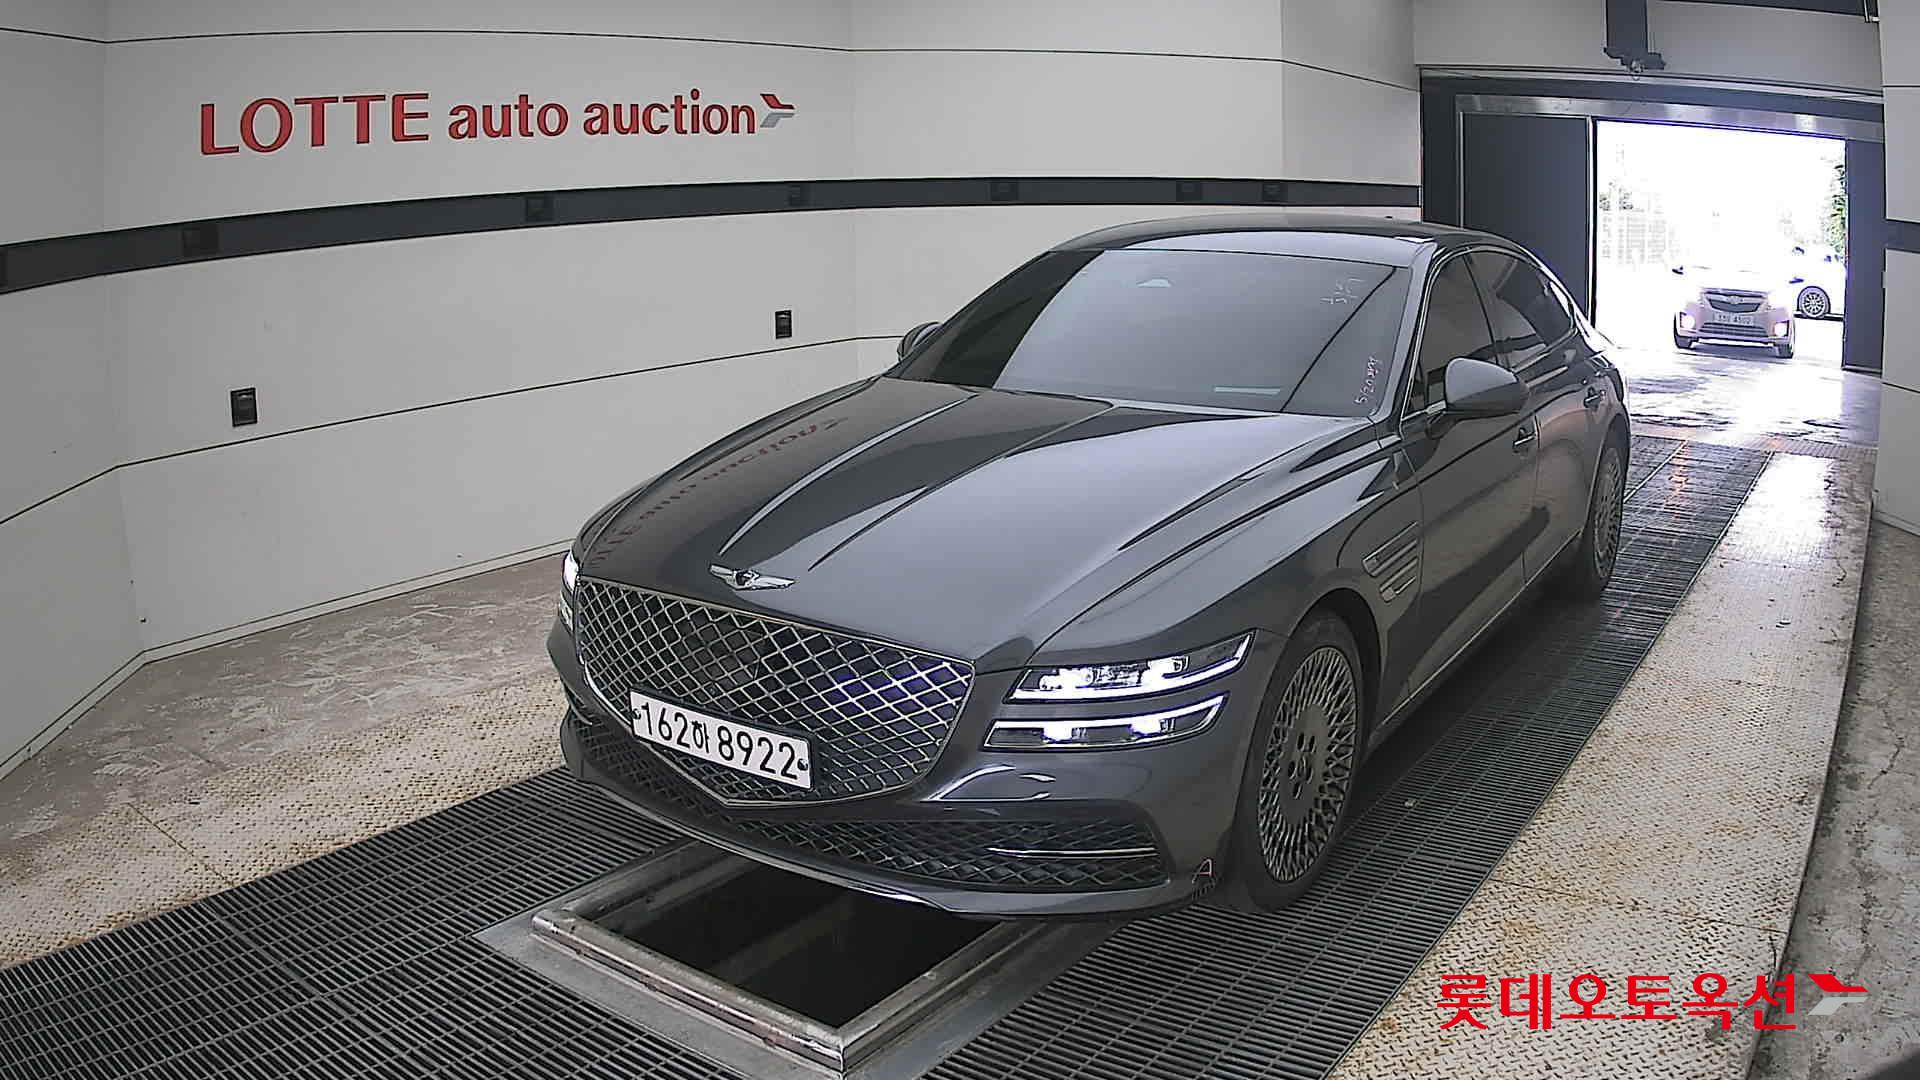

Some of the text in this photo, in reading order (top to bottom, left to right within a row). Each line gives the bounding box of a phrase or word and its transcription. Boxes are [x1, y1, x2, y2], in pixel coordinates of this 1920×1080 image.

[201, 89, 757, 155] LOTTE auto auction
[640, 702, 798, 780] 162하 8922
